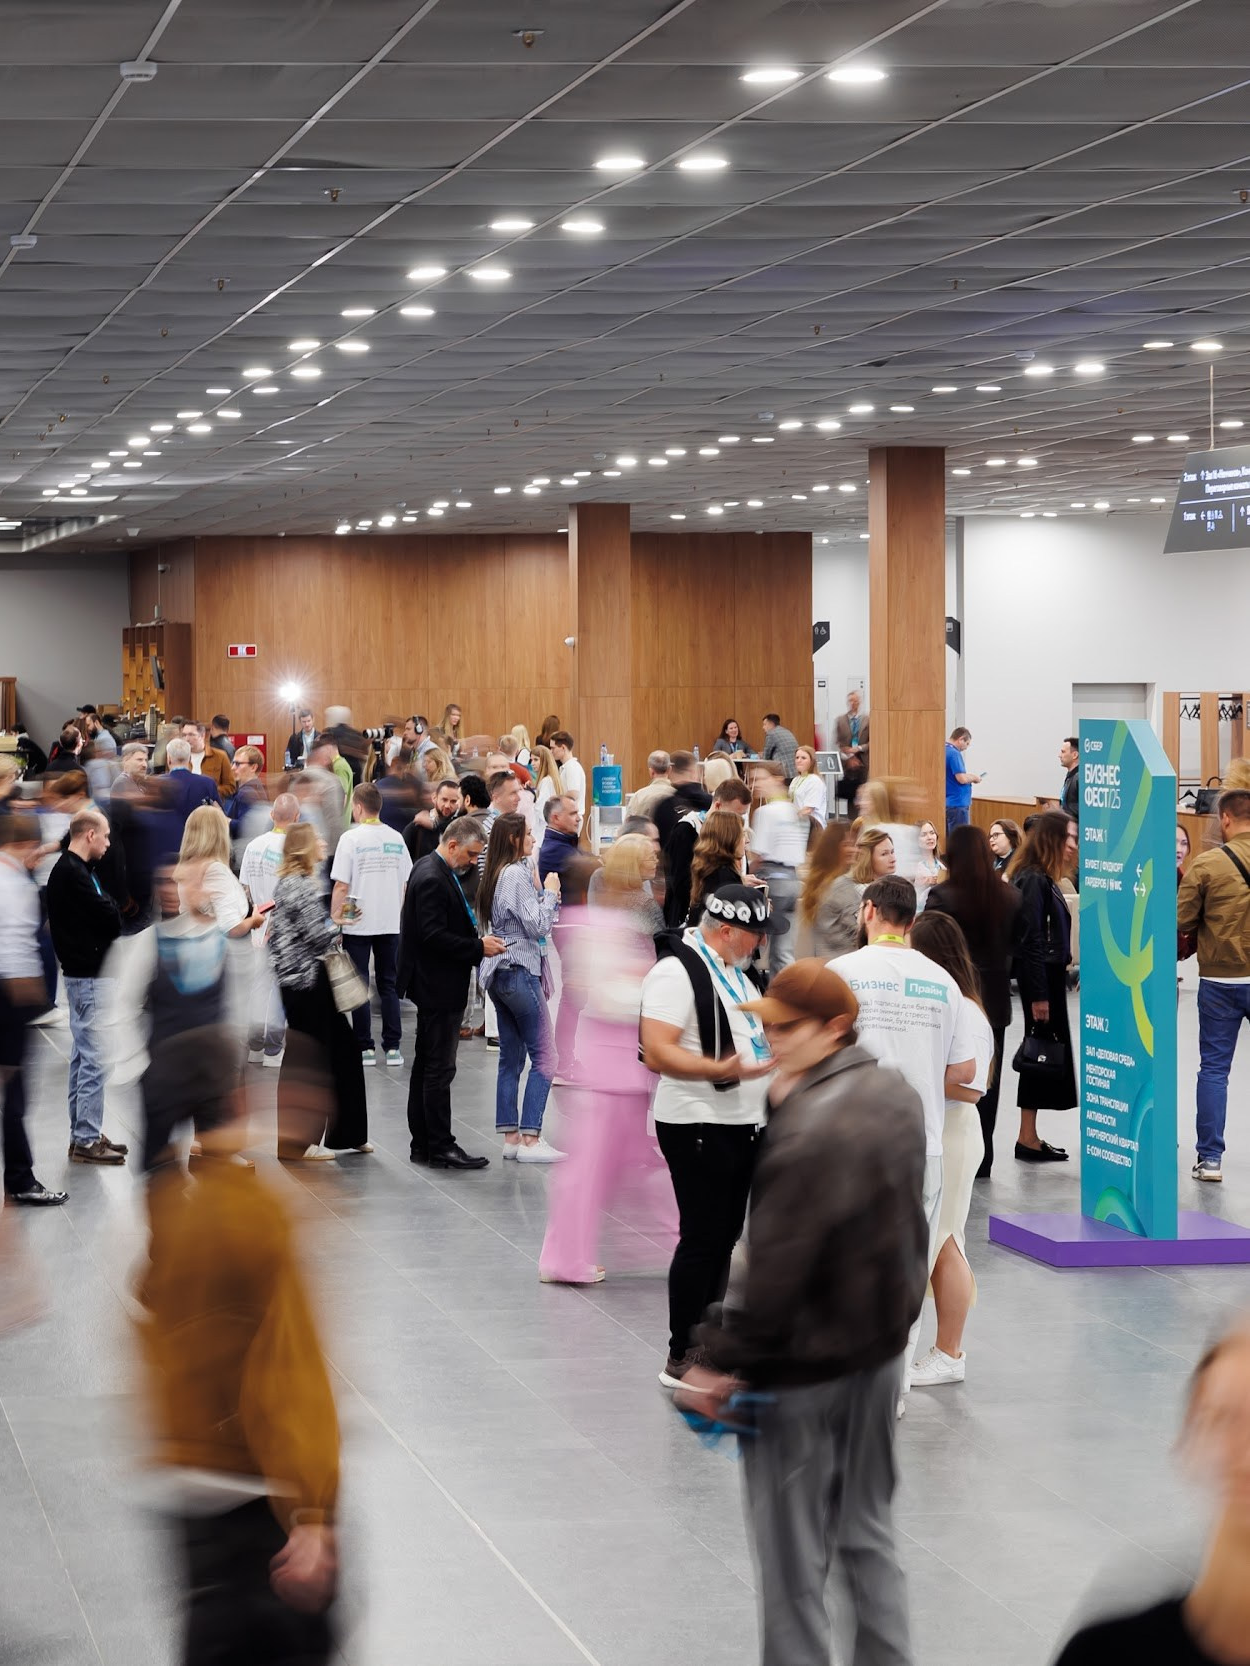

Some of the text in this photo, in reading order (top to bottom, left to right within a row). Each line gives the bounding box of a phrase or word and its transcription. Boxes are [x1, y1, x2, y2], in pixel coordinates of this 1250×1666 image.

[1084, 763, 1121, 786] БИЗНЕС
[1084, 786, 1121, 809] ФЕСТ/25
[1085, 827, 1104, 843] ЭТАЖ
[708, 895, 770, 923] DSQU
[850, 979, 899, 992] Бизнес
[1085, 1014, 1109, 1033] ЭТАЖ 2
[1085, 1063, 1116, 1080] МЕНТОРСКАЯ
[1085, 1074, 1110, 1090] ГОСТИНАЯ
[1086, 1092, 1099, 1105] ЗОНА
